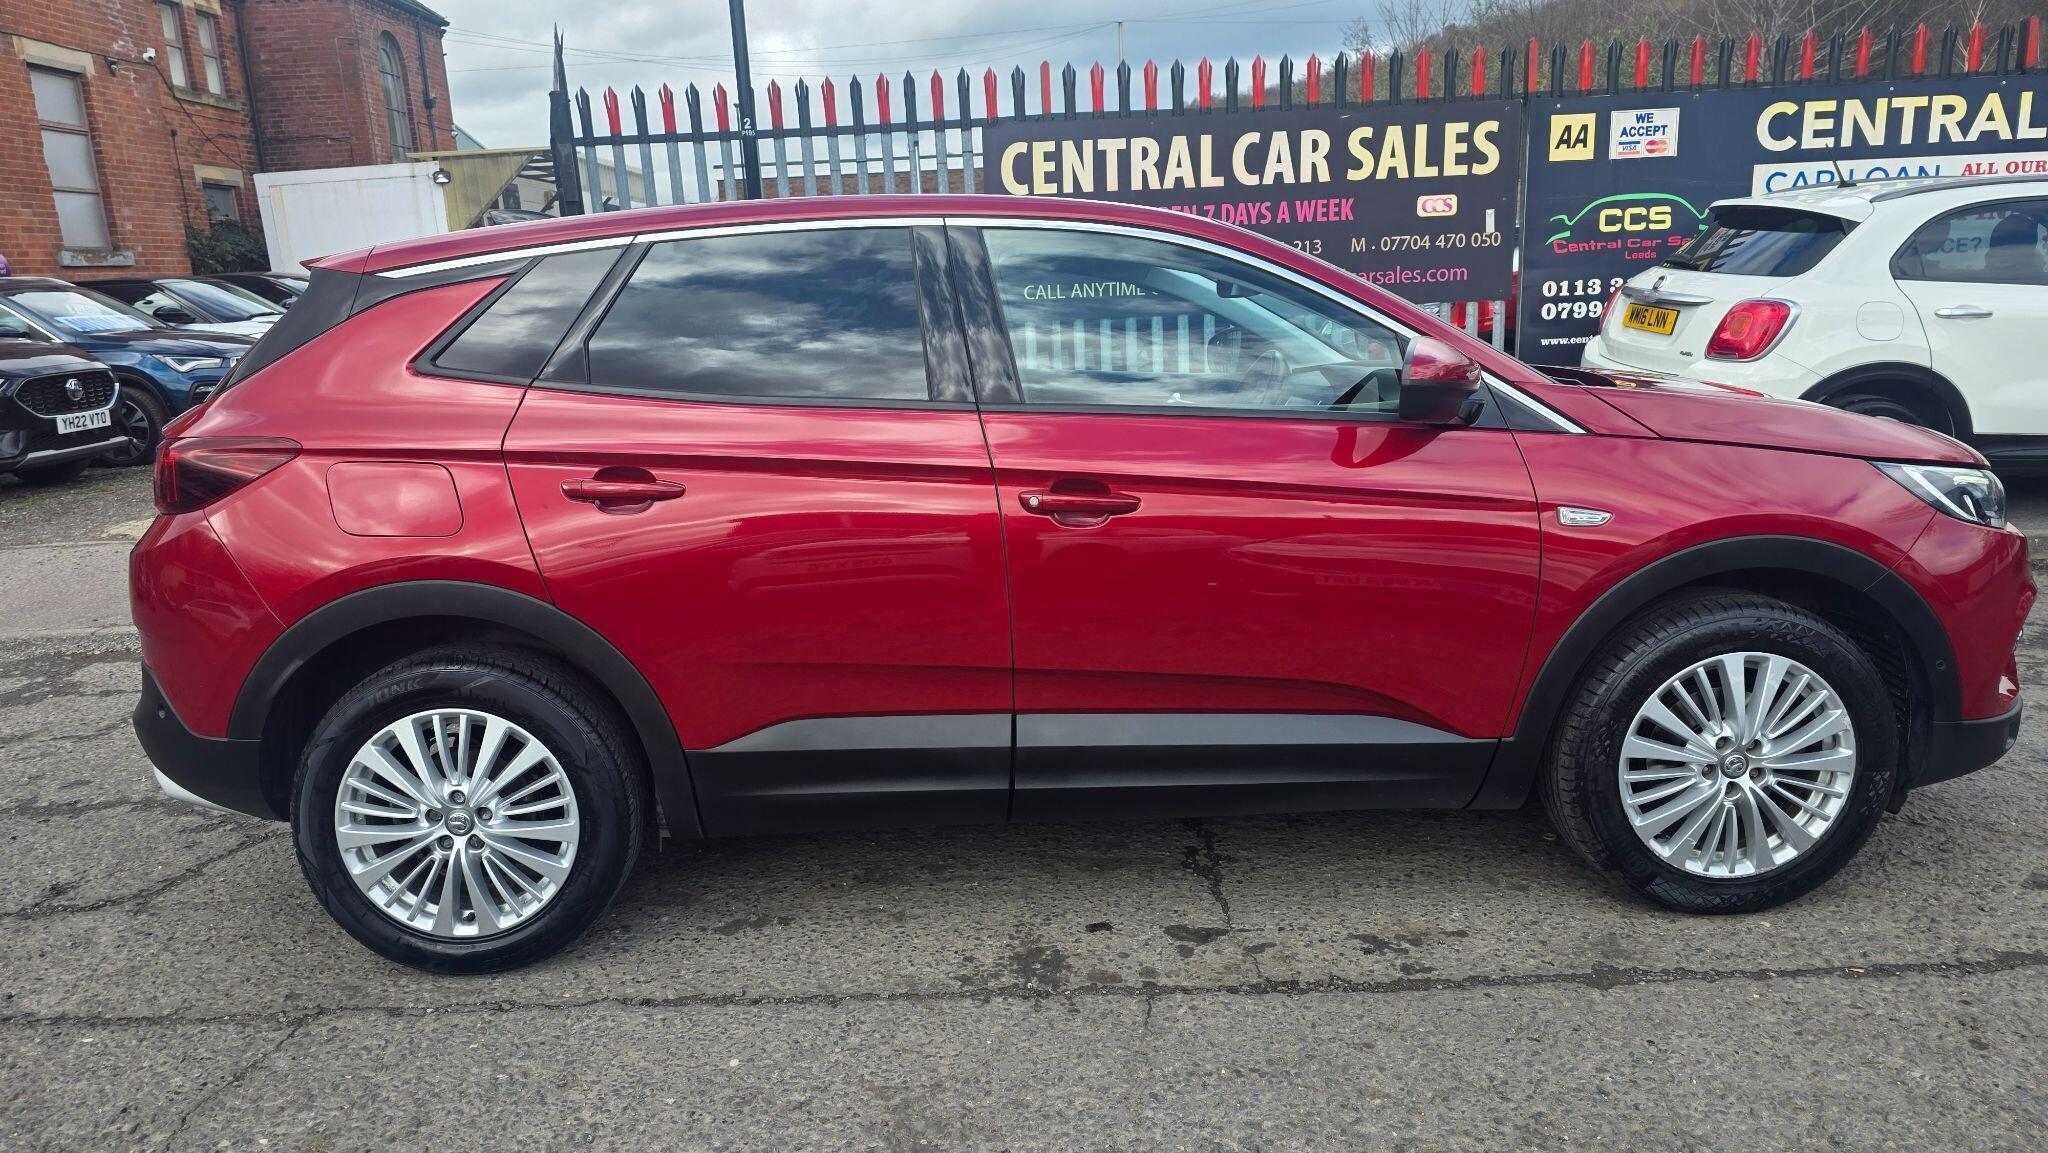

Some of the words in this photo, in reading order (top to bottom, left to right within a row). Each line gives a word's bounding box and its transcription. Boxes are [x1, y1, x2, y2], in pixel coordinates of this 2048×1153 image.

[743, 118, 751, 128] 2
[1635, 113, 1655, 124] WE
[1756, 91, 2048, 152] CENTRAL
[1554, 123, 1590, 150] AA
[1620, 125, 1668, 138] ACCEPT
[1000, 134, 1225, 196] CENTRAL
[1231, 129, 1331, 187] CAR
[1346, 120, 1500, 181] SALES
[1961, 162, 1999, 177] ALL
[2005, 159, 2048, 174] OUR
[1221, 201, 1272, 226] DAYS
[1277, 200, 1291, 224] A
[1296, 198, 1355, 223] WEEK
[1421, 198, 1454, 213] CCS
[1598, 205, 1672, 233] CCS
[1350, 237, 1366, 253] M
[1380, 235, 1431, 252] 07704
[1435, 233, 1466, 249] 470
[1471, 231, 1501, 247] 050
[1552, 238, 1622, 254] Central
[1626, 237, 1662, 248] Car
[1625, 249, 1657, 260] Leeds
[1355, 265, 1468, 285] arsales.com
[1024, 284, 1066, 300] CALL
[1542, 278, 1602, 297] 0113
[1628, 306, 1649, 325] WM16
[1647, 309, 1670, 329] LNN
[62, 415, 88, 430] YH22
[89, 412, 107, 426] VTO
